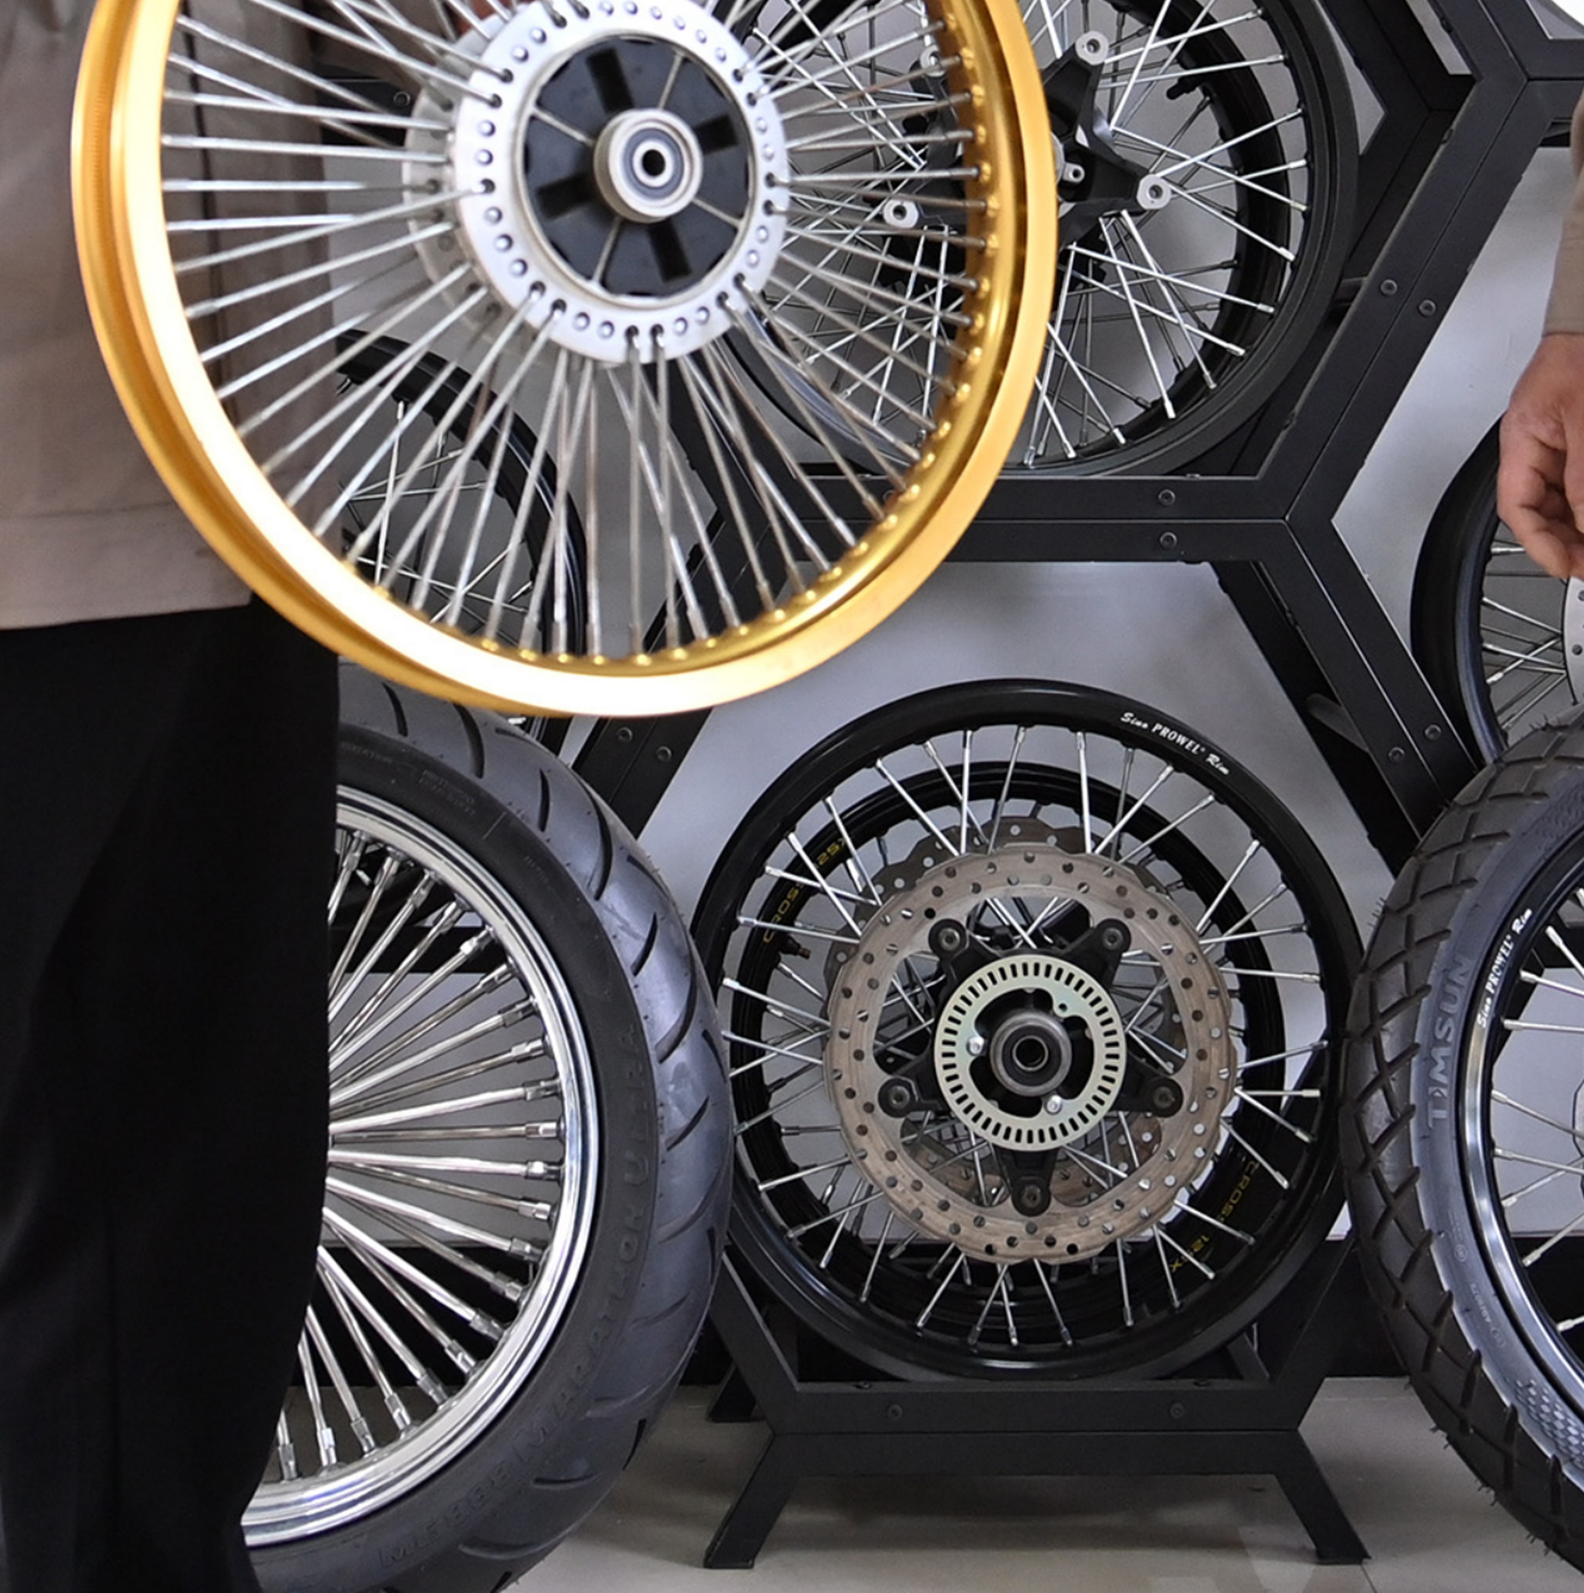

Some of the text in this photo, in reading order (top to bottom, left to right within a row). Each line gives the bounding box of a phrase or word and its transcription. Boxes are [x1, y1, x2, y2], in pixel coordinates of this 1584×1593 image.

[1119, 711, 1230, 776] Sino PROWEL Rim
[1476, 907, 1533, 1029] Sino PROWEL Rim
[1427, 953, 1474, 1130] TIMSUN
